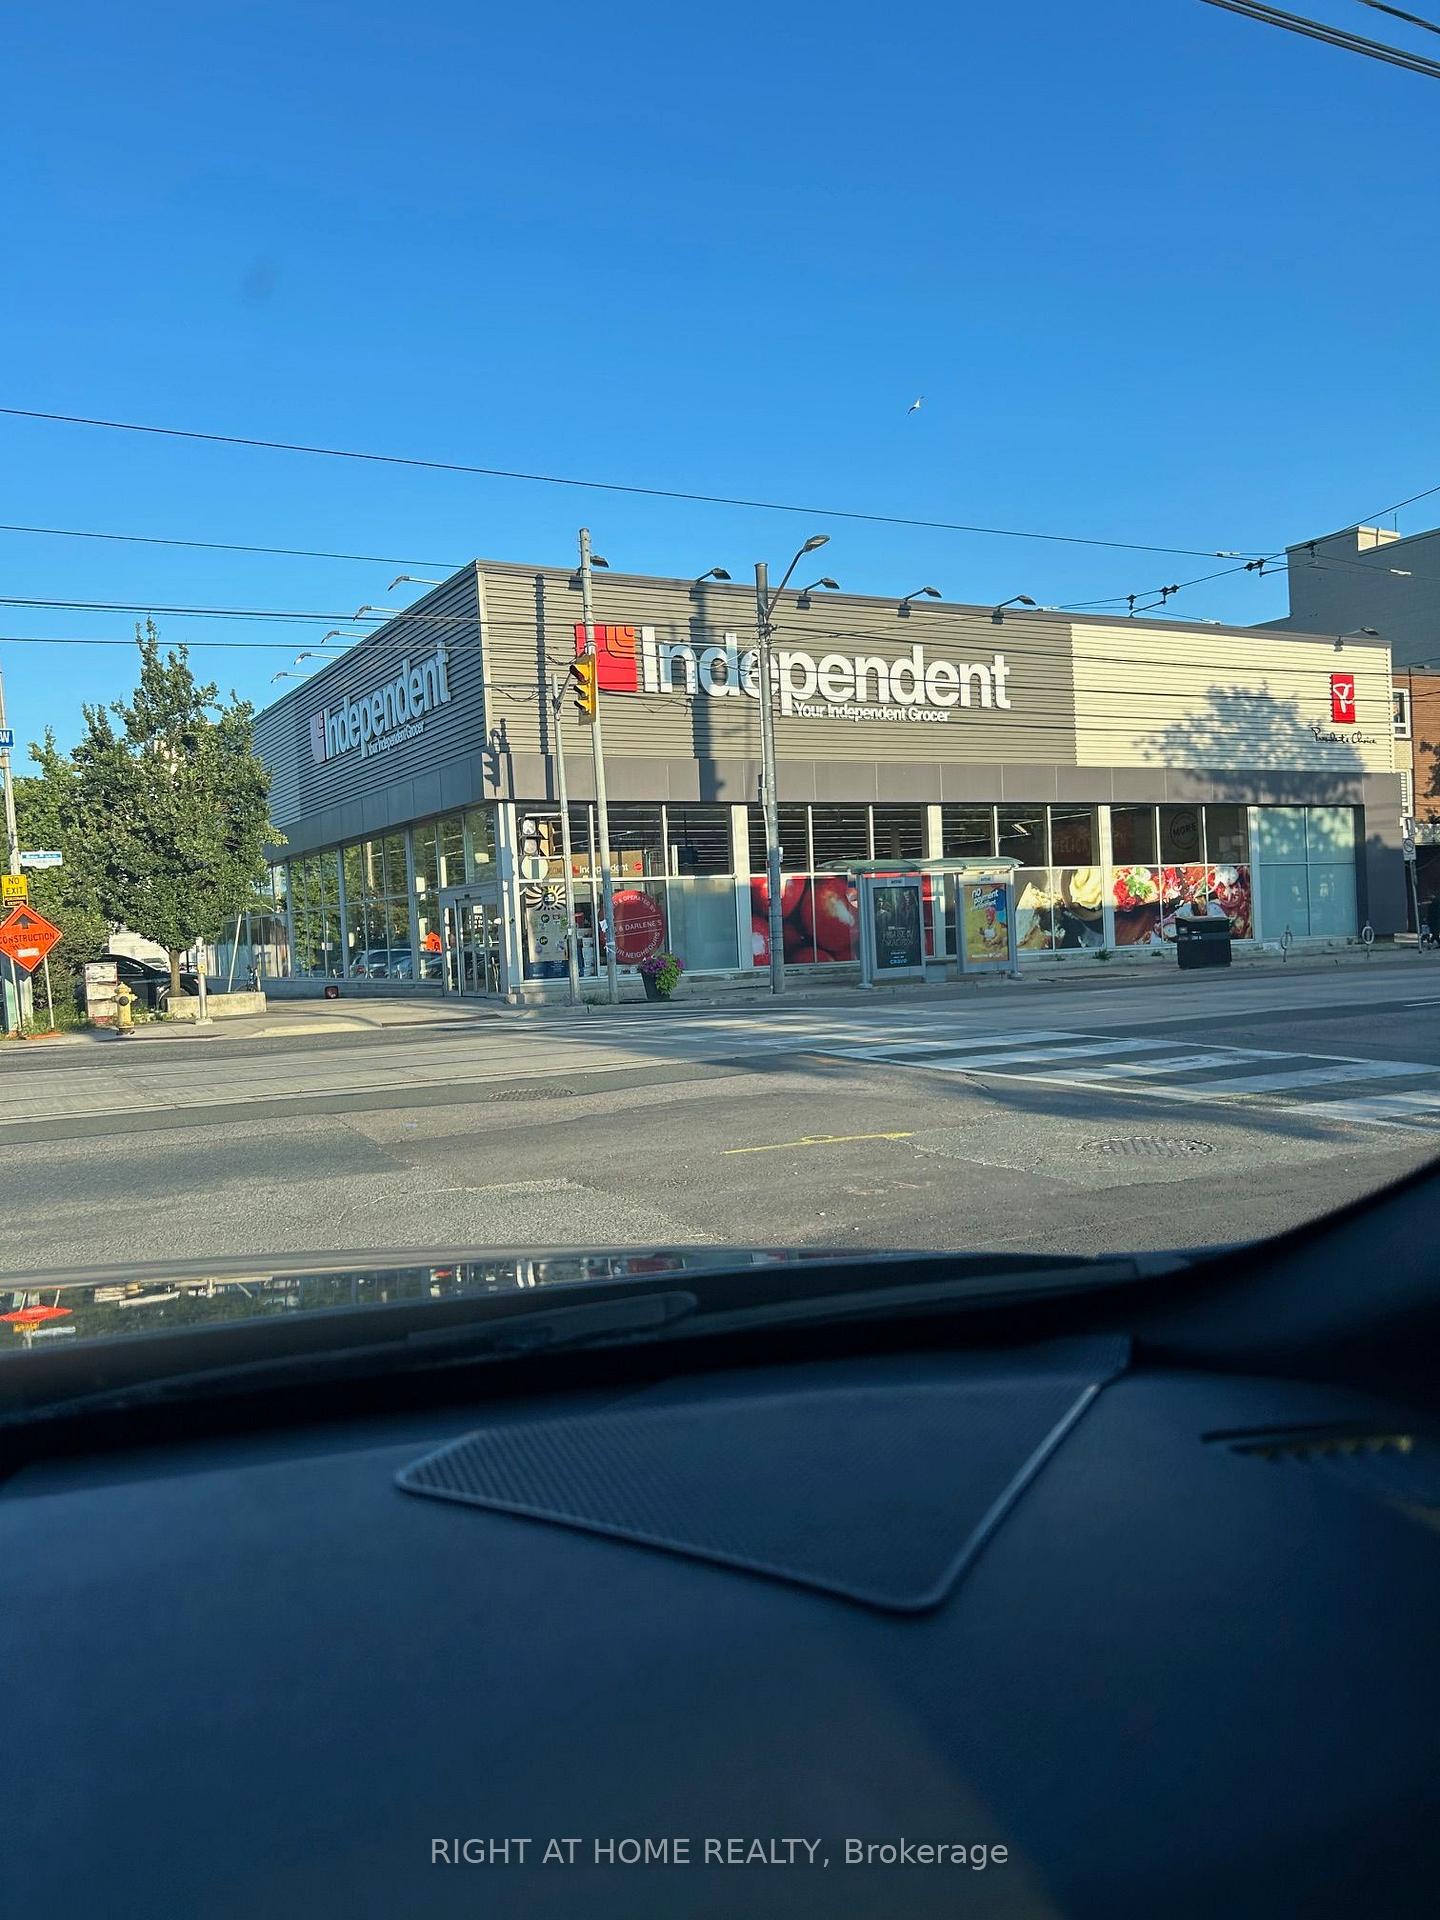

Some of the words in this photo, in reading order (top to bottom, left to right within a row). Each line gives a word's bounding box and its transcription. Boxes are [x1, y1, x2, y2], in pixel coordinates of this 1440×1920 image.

[641, 626, 1011, 715] Independent
[323, 641, 452, 760] Independent
[796, 702, 825, 718] Your
[827, 703, 907, 722] Independent
[908, 708, 950, 722] Grocer
[1351, 731, 1377, 743] Choice
[8, 877, 20, 885] NO
[6, 887, 23, 895] EXIT
